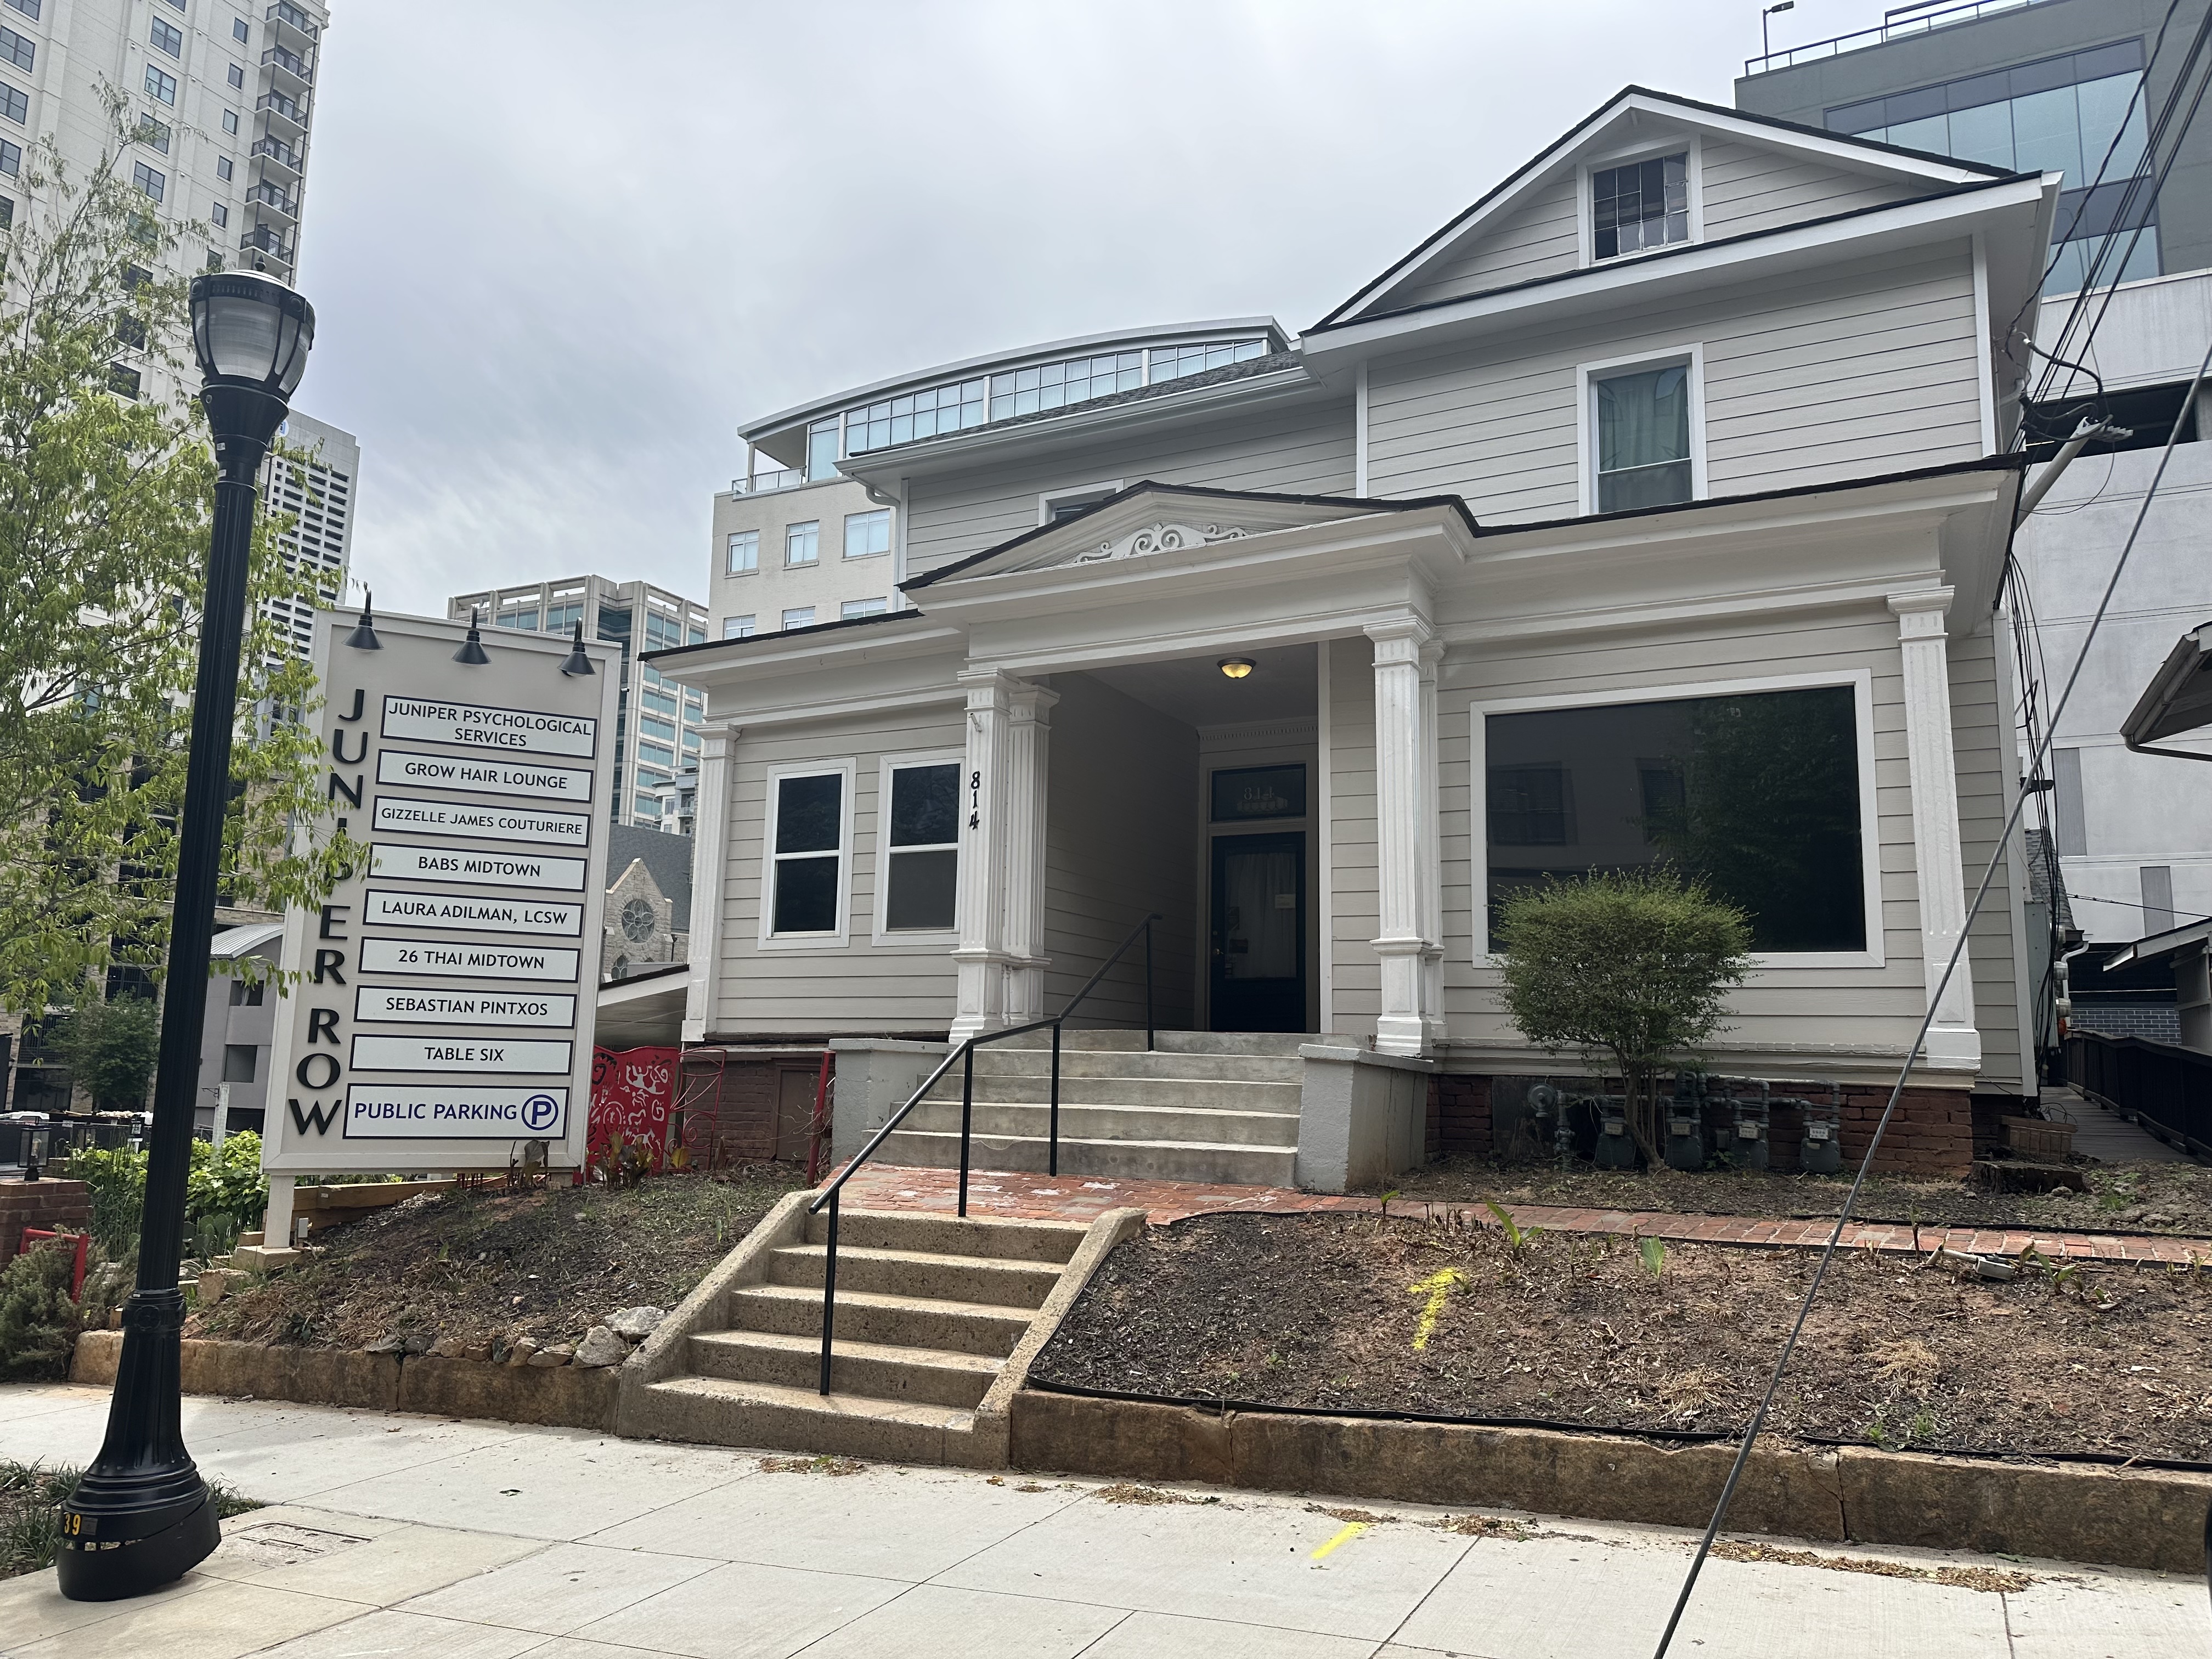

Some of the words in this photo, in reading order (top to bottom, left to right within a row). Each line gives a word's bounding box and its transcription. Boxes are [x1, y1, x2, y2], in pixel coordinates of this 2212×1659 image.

[388, 702, 458, 721] JUNIPER
[463, 710, 591, 736] PSYCHOLOGICAL
[454, 727, 527, 747] SERVICES
[405, 762, 456, 778] GROW
[460, 768, 498, 783] HAIR
[504, 771, 568, 789] LOUNGE
[969, 771, 980, 830] 814
[1244, 786, 1274, 800] 814
[381, 808, 446, 823] GIZZELLE
[449, 814, 494, 827] JAMES
[498, 817, 583, 834] COUTURIERE
[418, 856, 459, 871] BABS
[464, 861, 540, 877] MIDTOWN
[382, 900, 437, 917] LAURA
[439, 905, 517, 924] ADILMAN,
[524, 910, 568, 924] LCSW
[398, 949, 418, 963] 26
[425, 951, 462, 965] THAI
[467, 953, 545, 969] MIDTOWN
[386, 997, 475, 1013] SEBASTIAN
[481, 1001, 548, 1016] PINTXOS
[424, 1047, 475, 1061] TABLE
[479, 1048, 505, 1062] SIX
[288, 1008, 342, 1137] ROW
[354, 1103, 426, 1119] PUBLIC
[433, 1104, 517, 1120] PARKING
[64, 1513, 81, 1536] 39
